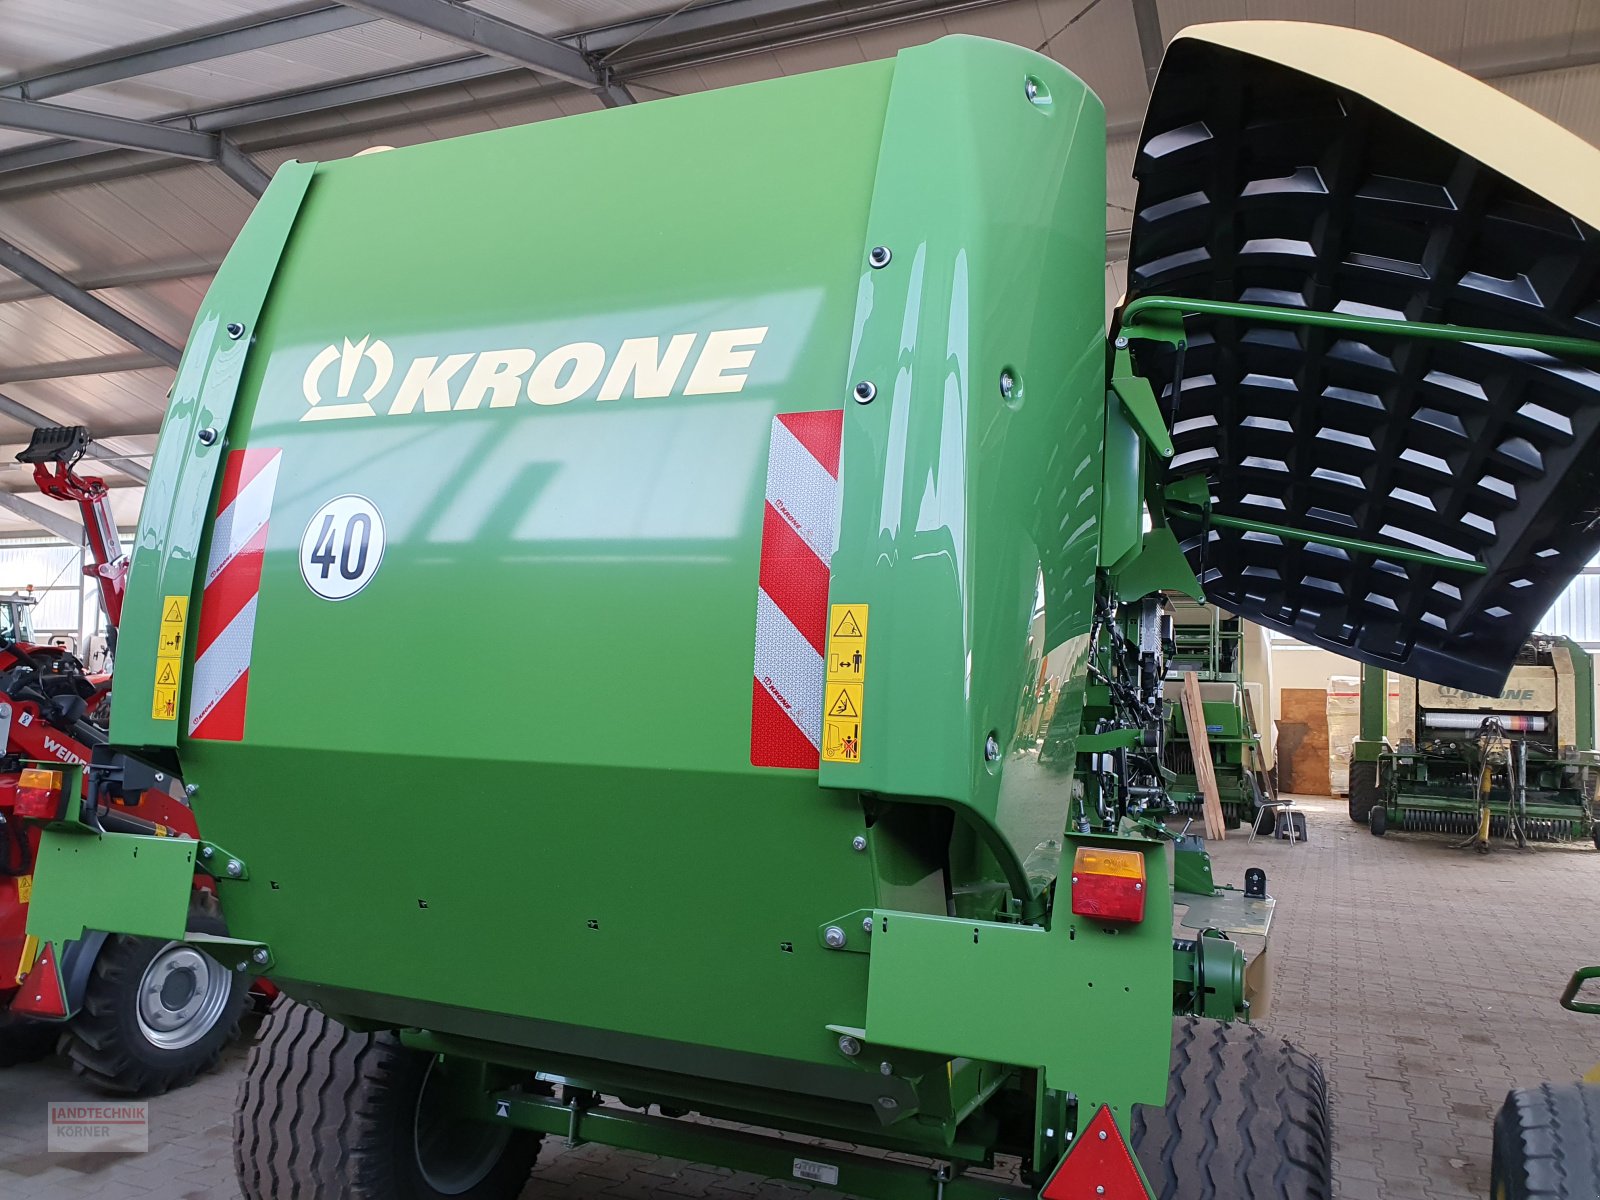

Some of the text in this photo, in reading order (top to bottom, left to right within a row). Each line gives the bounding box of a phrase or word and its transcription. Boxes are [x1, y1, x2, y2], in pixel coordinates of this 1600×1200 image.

[387, 326, 769, 416] KRONE
[310, 512, 371, 581] 40
[769, 685, 792, 709] KRONE
[1460, 690, 1535, 700] KNE
